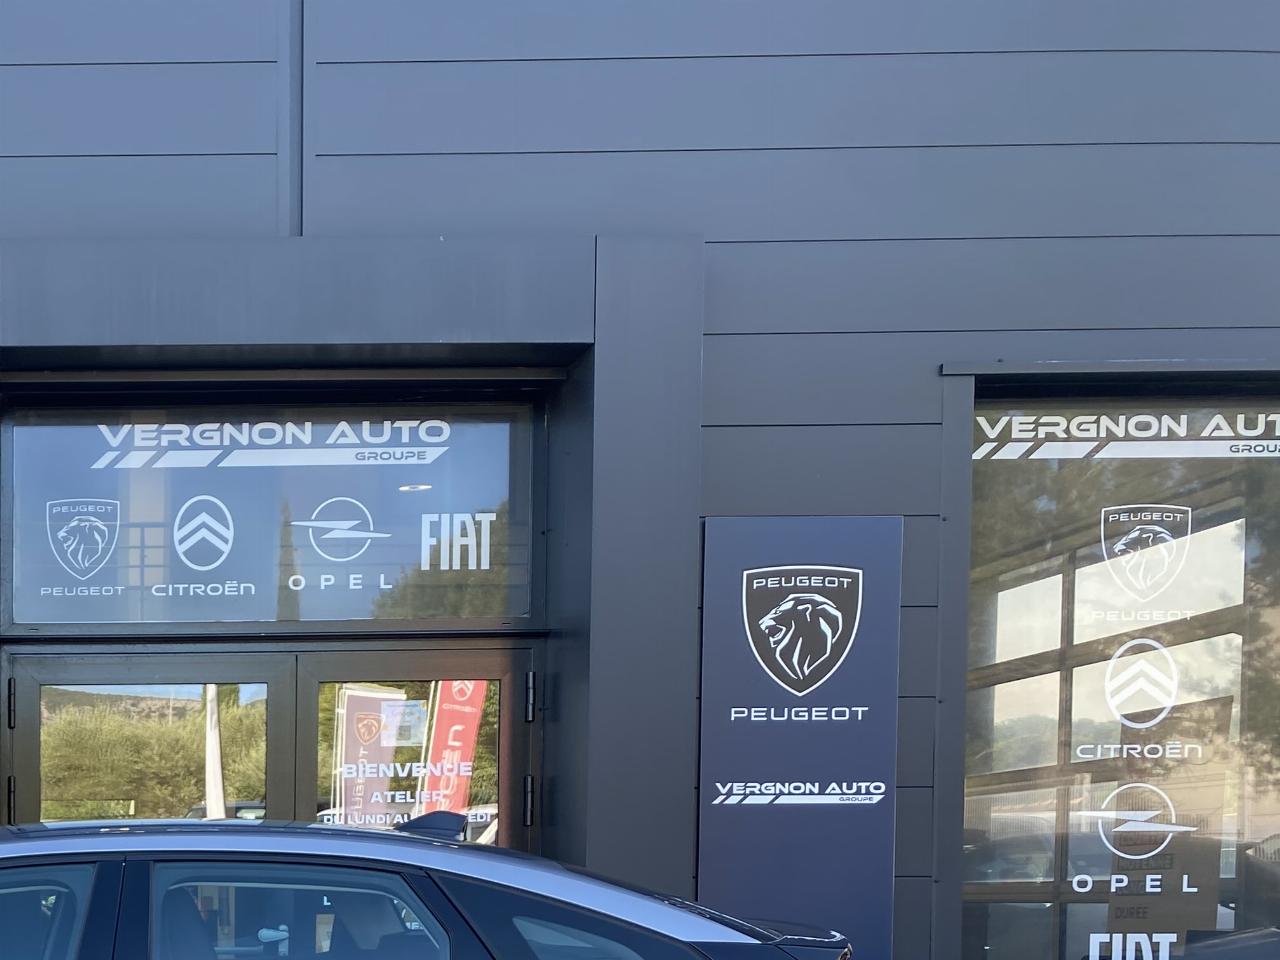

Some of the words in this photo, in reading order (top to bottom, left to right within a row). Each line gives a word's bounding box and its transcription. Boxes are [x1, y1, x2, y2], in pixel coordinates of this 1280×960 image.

[975, 414, 1187, 439] VERGNON
[97, 421, 312, 447] VERGNON
[325, 420, 451, 444] AUTO
[1229, 444, 1280, 453] GROU
[355, 451, 427, 461] GROUPE
[53, 505, 113, 513] PEUGEOT
[1109, 512, 1184, 522] PEUGEOT
[420, 513, 496, 570] FIAT
[288, 574, 393, 590] OPEL
[753, 576, 852, 589] PEUGEOT
[41, 586, 125, 596] PEUGEOT
[1091, 610, 1196, 621] PEUGEOT
[730, 707, 869, 721] PEUGEOT
[342, 762, 472, 778] BIENVENUE
[715, 781, 821, 794] VERGNON
[825, 781, 886, 794] AUTO
[371, 790, 443, 803] ATELIER
[348, 814, 389, 824] LUNDI
[1072, 874, 1198, 893] OPEL
